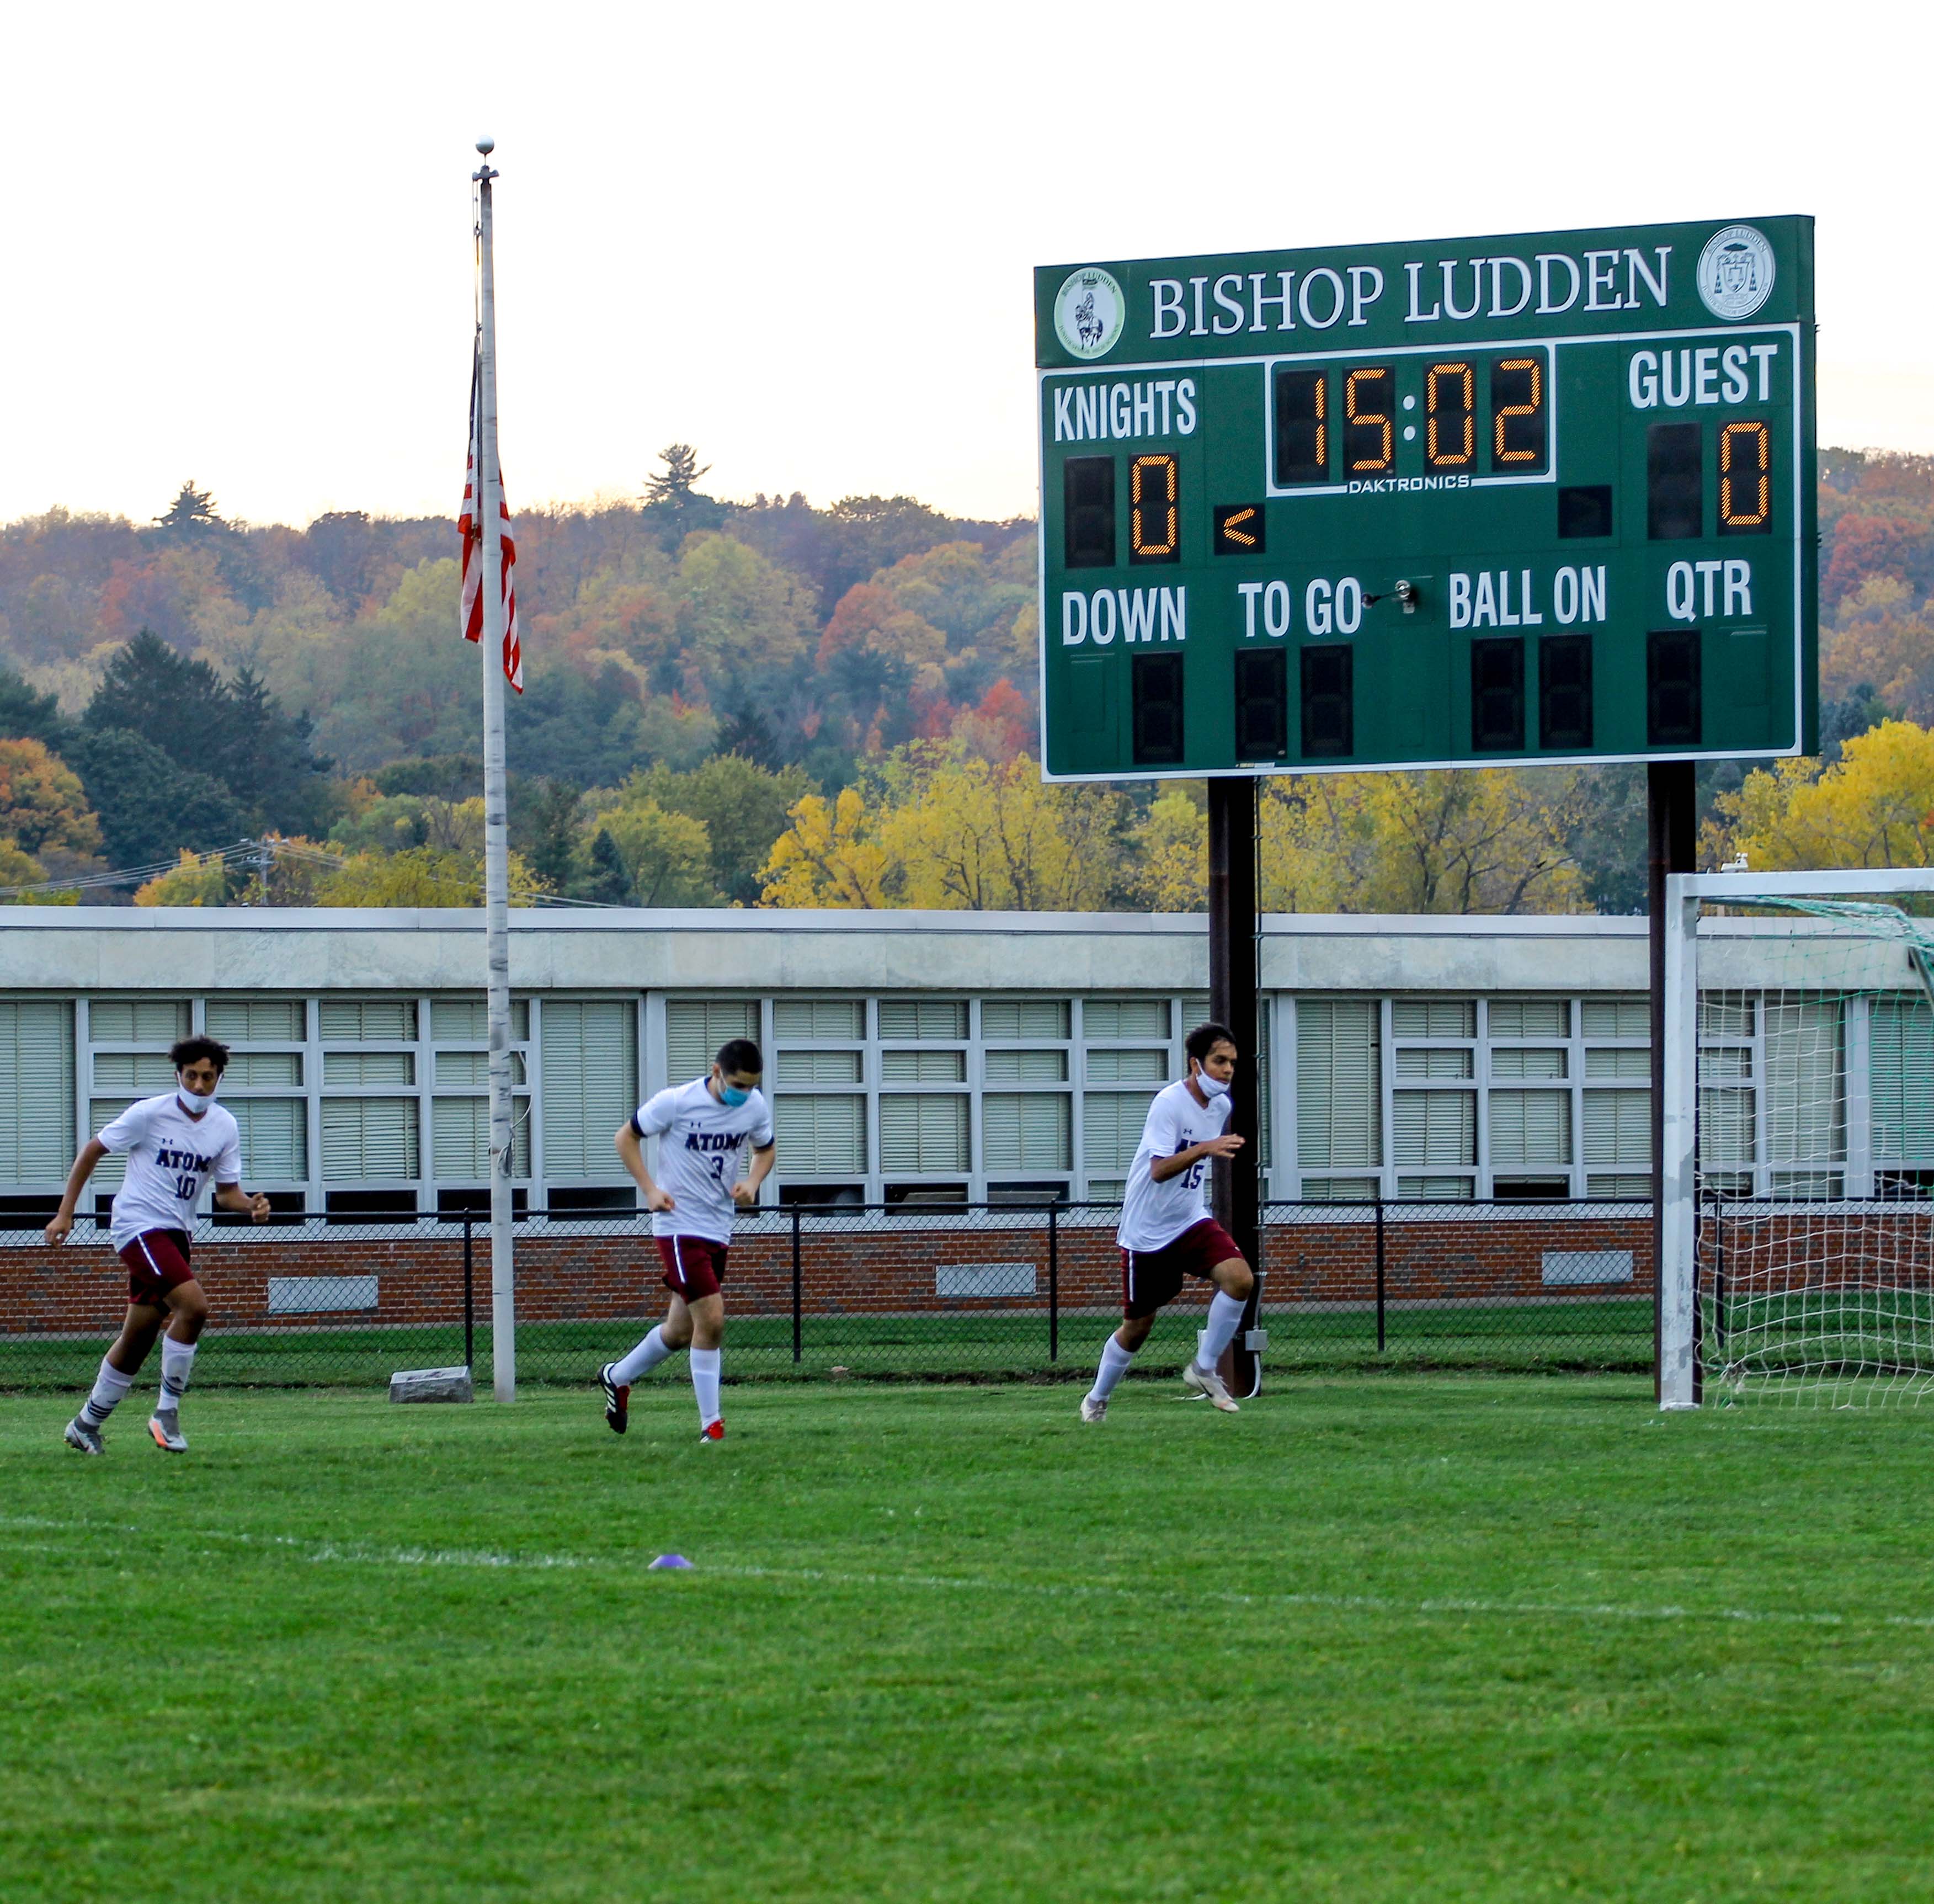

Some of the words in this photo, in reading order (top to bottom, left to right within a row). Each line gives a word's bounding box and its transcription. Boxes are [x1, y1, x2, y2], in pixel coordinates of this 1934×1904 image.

[1149, 266, 1384, 338] BISHOP
[1404, 246, 1672, 322] LUDDEN
[1629, 344, 1778, 408] GUEST
[1054, 379, 1196, 442] KNIGHTS
[1315, 359, 1540, 470] 15:02
[1132, 455, 1175, 555] 0
[1348, 475, 1471, 494] DAKTRONICS
[1721, 422, 1768, 525] 0
[1062, 586, 1186, 646] DOWN
[1238, 580, 1290, 638] TO
[1305, 577, 1362, 635] GO
[1449, 569, 1542, 628] BALL
[1553, 565, 1606, 624] ON
[1666, 559, 1752, 623] QTR
[175, 1174, 196, 1200] 10
[1181, 1164, 1204, 1189] 15
